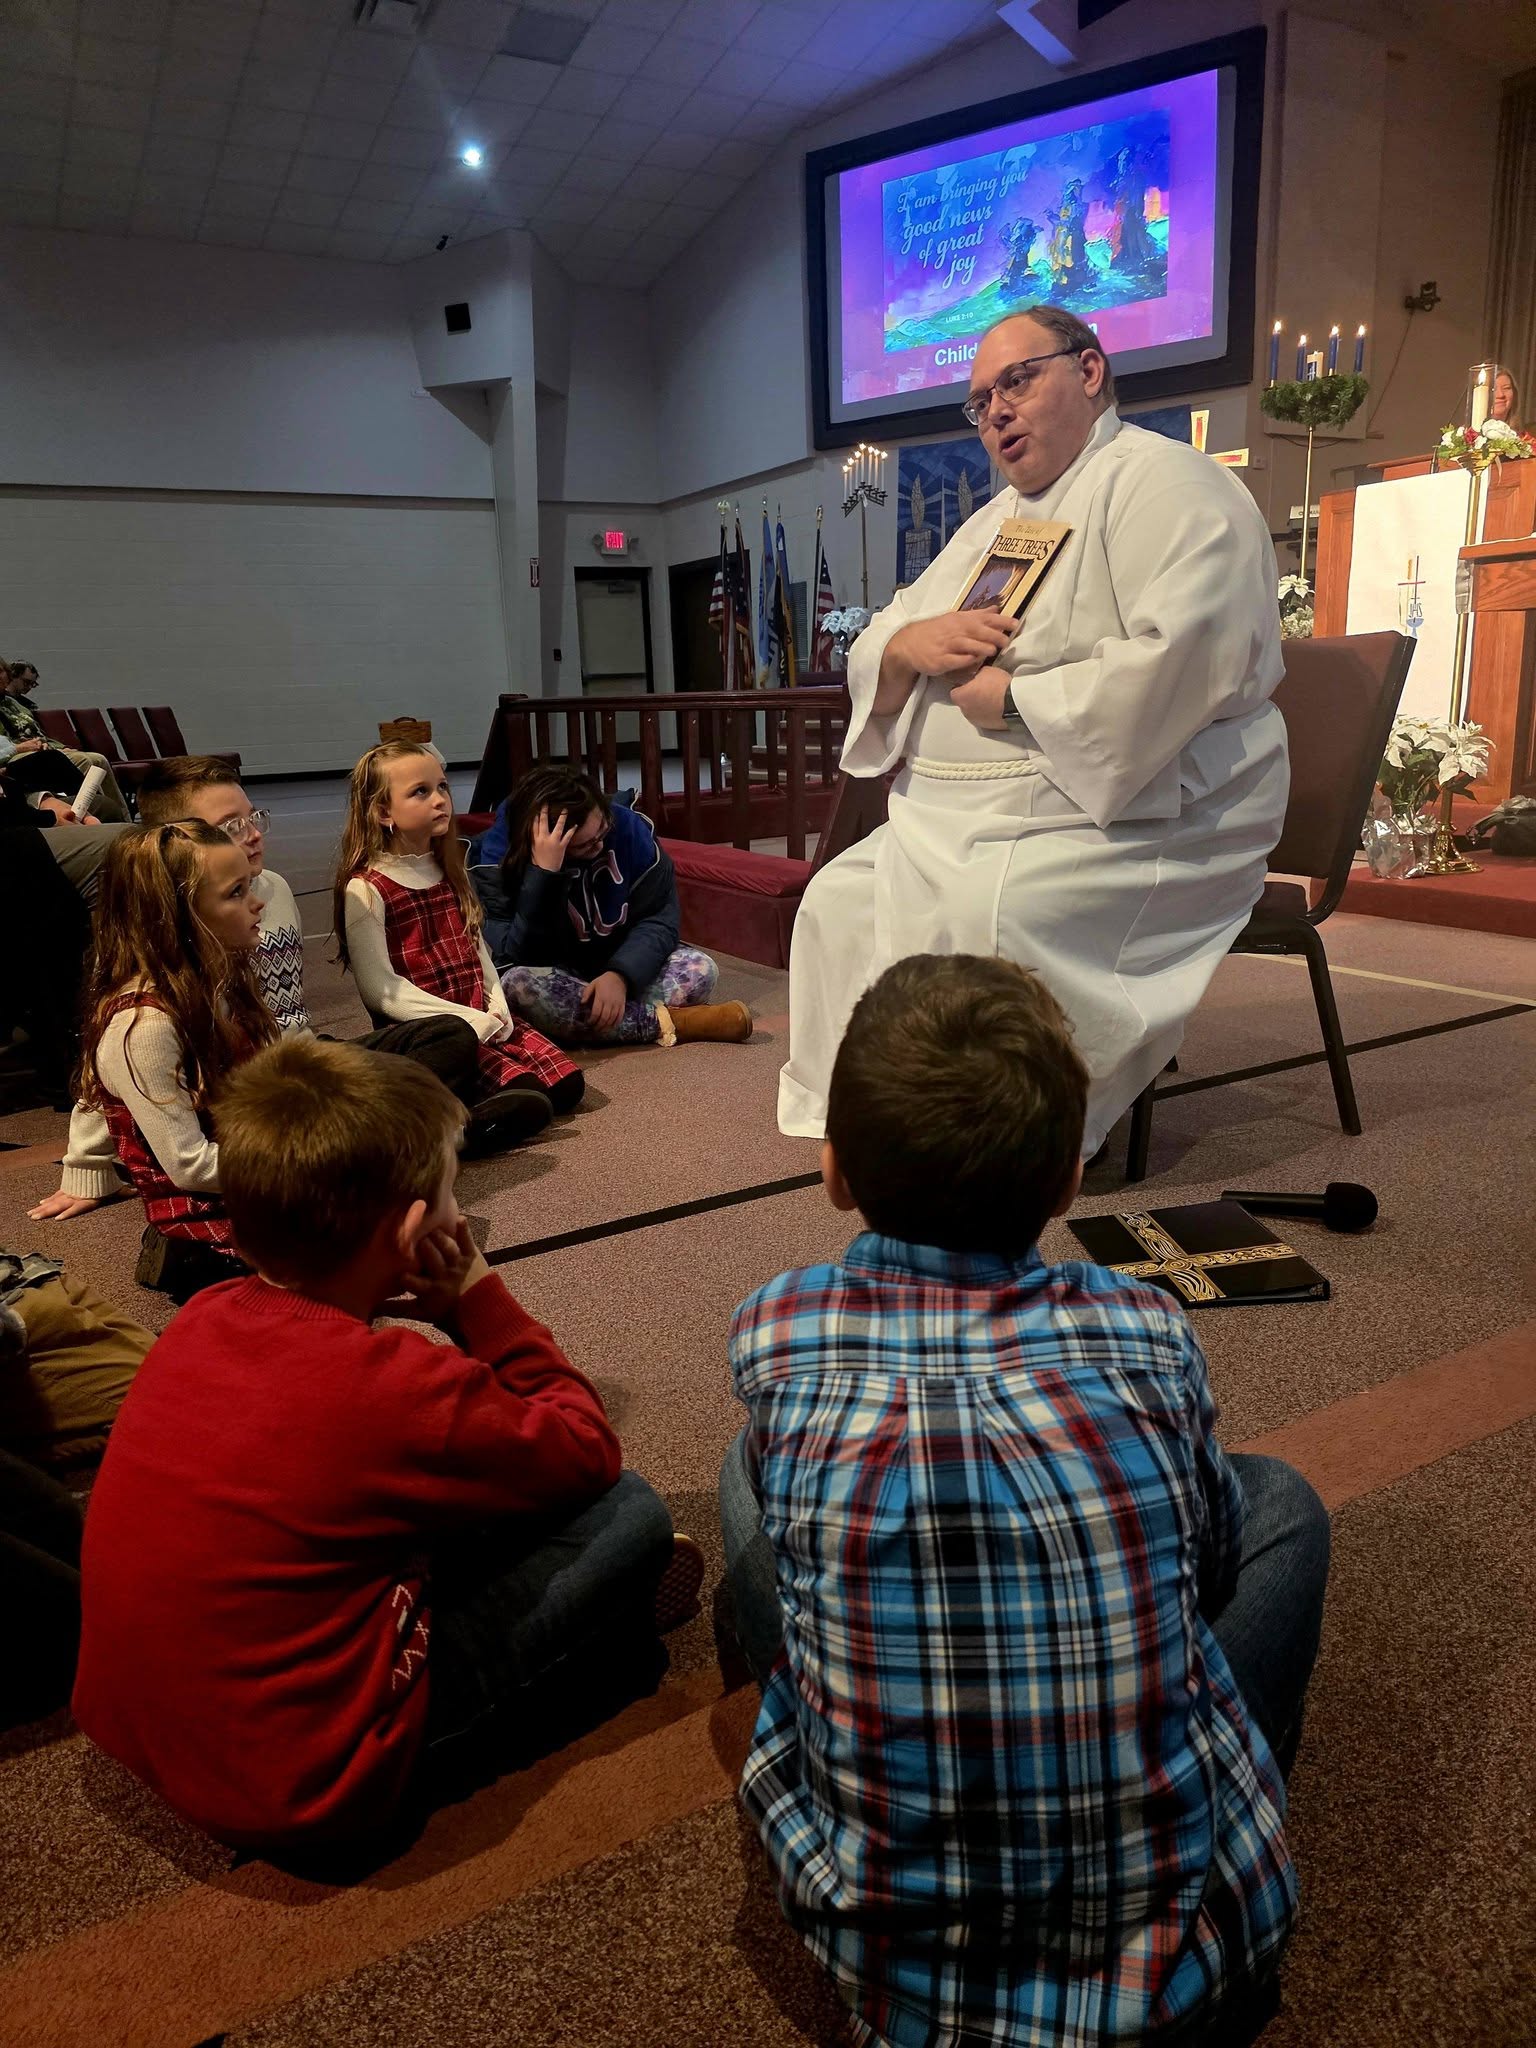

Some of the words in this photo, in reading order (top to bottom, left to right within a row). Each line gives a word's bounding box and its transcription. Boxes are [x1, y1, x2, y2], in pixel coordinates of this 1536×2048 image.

[914, 194, 937, 208] am
[940, 177, 998, 206] bringing
[999, 170, 1028, 198] you
[901, 203, 951, 255] good
[949, 205, 993, 228] news
[919, 239, 933, 268] of
[934, 223, 984, 270] great
[942, 254, 977, 289] joy
[945, 315, 961, 323] LUKE
[961, 312, 974, 320] 2:10
[934, 343, 978, 366] Child
[605, 531, 623, 549] EXIT
[988, 535, 1021, 554] THREE
[1019, 540, 1055, 560] TREES
